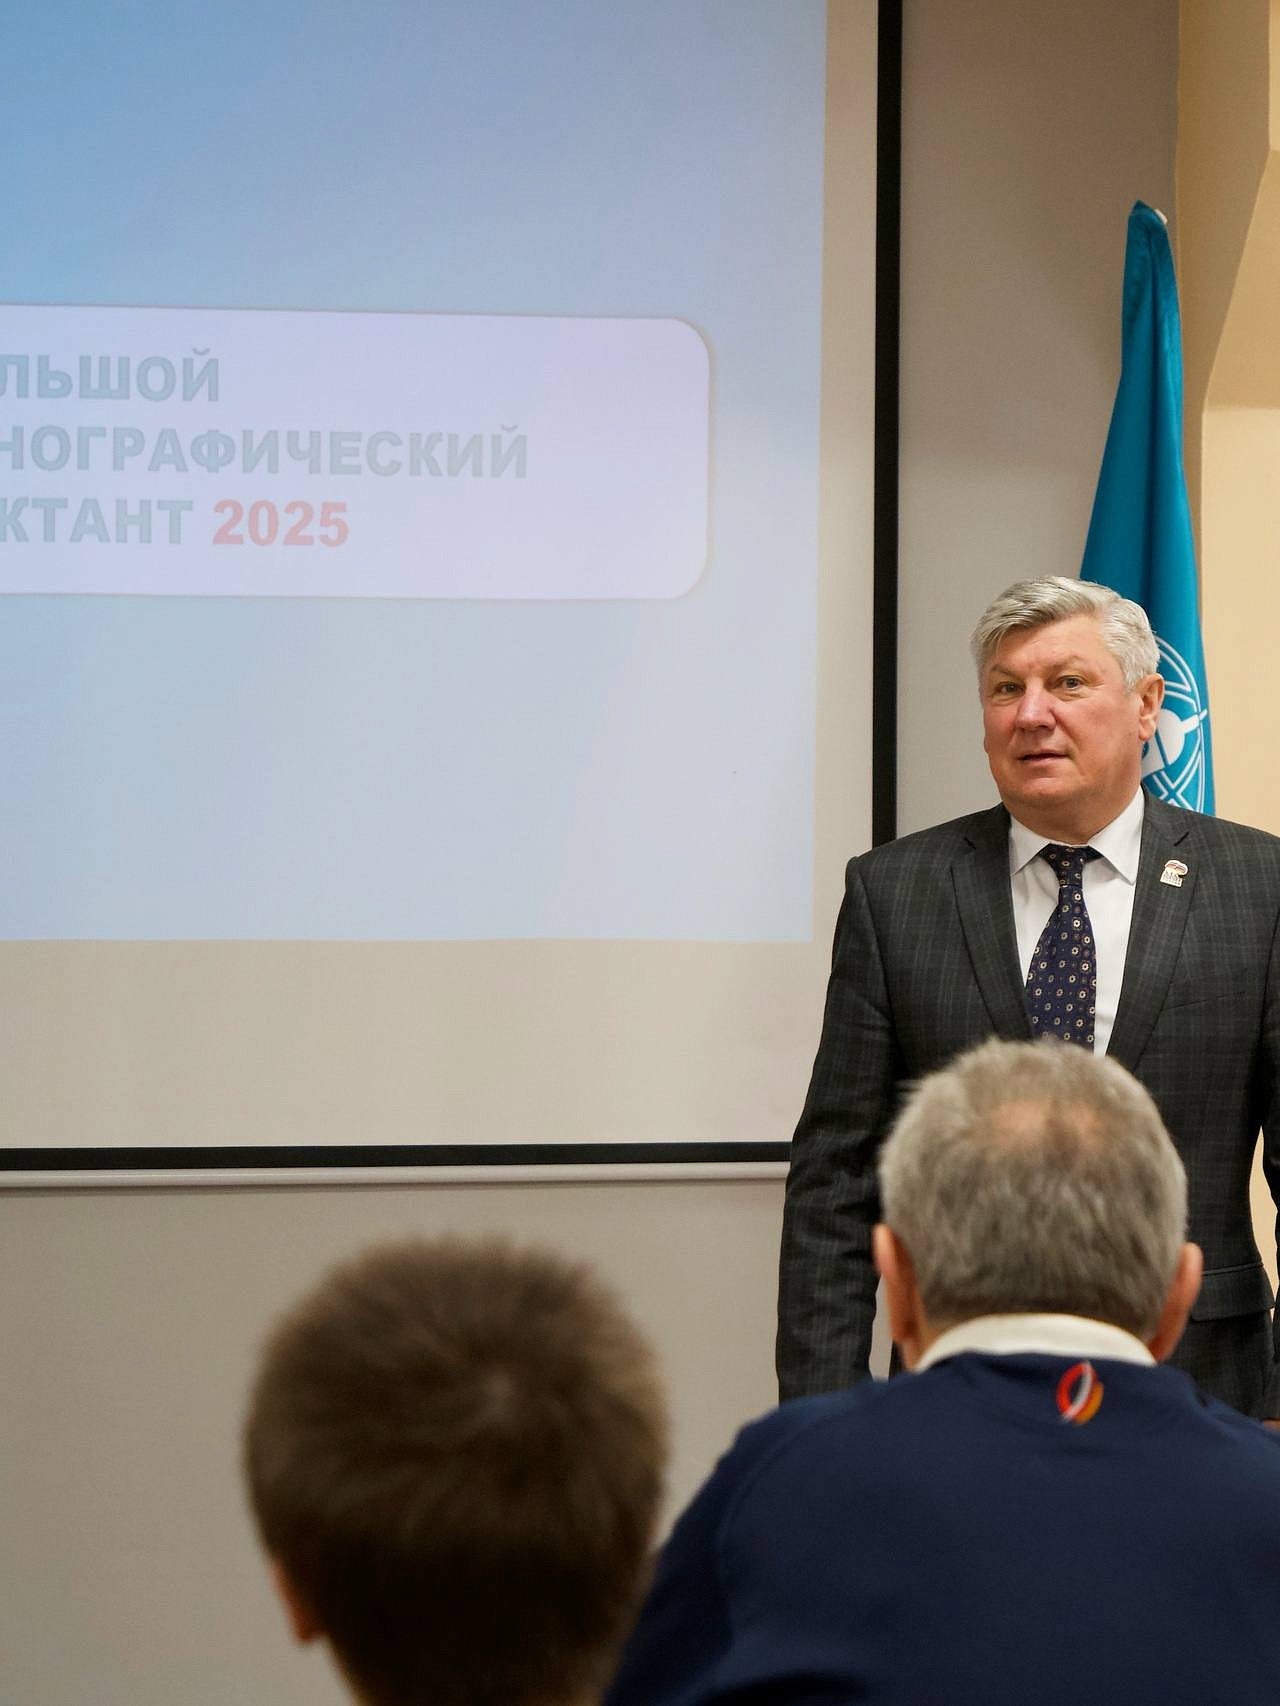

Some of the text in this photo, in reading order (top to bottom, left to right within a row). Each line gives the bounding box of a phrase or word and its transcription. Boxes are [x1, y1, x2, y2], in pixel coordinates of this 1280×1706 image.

[0, 348, 219, 401] ЛЬШОЙ
[0, 497, 348, 546] КТАНТ 2025
